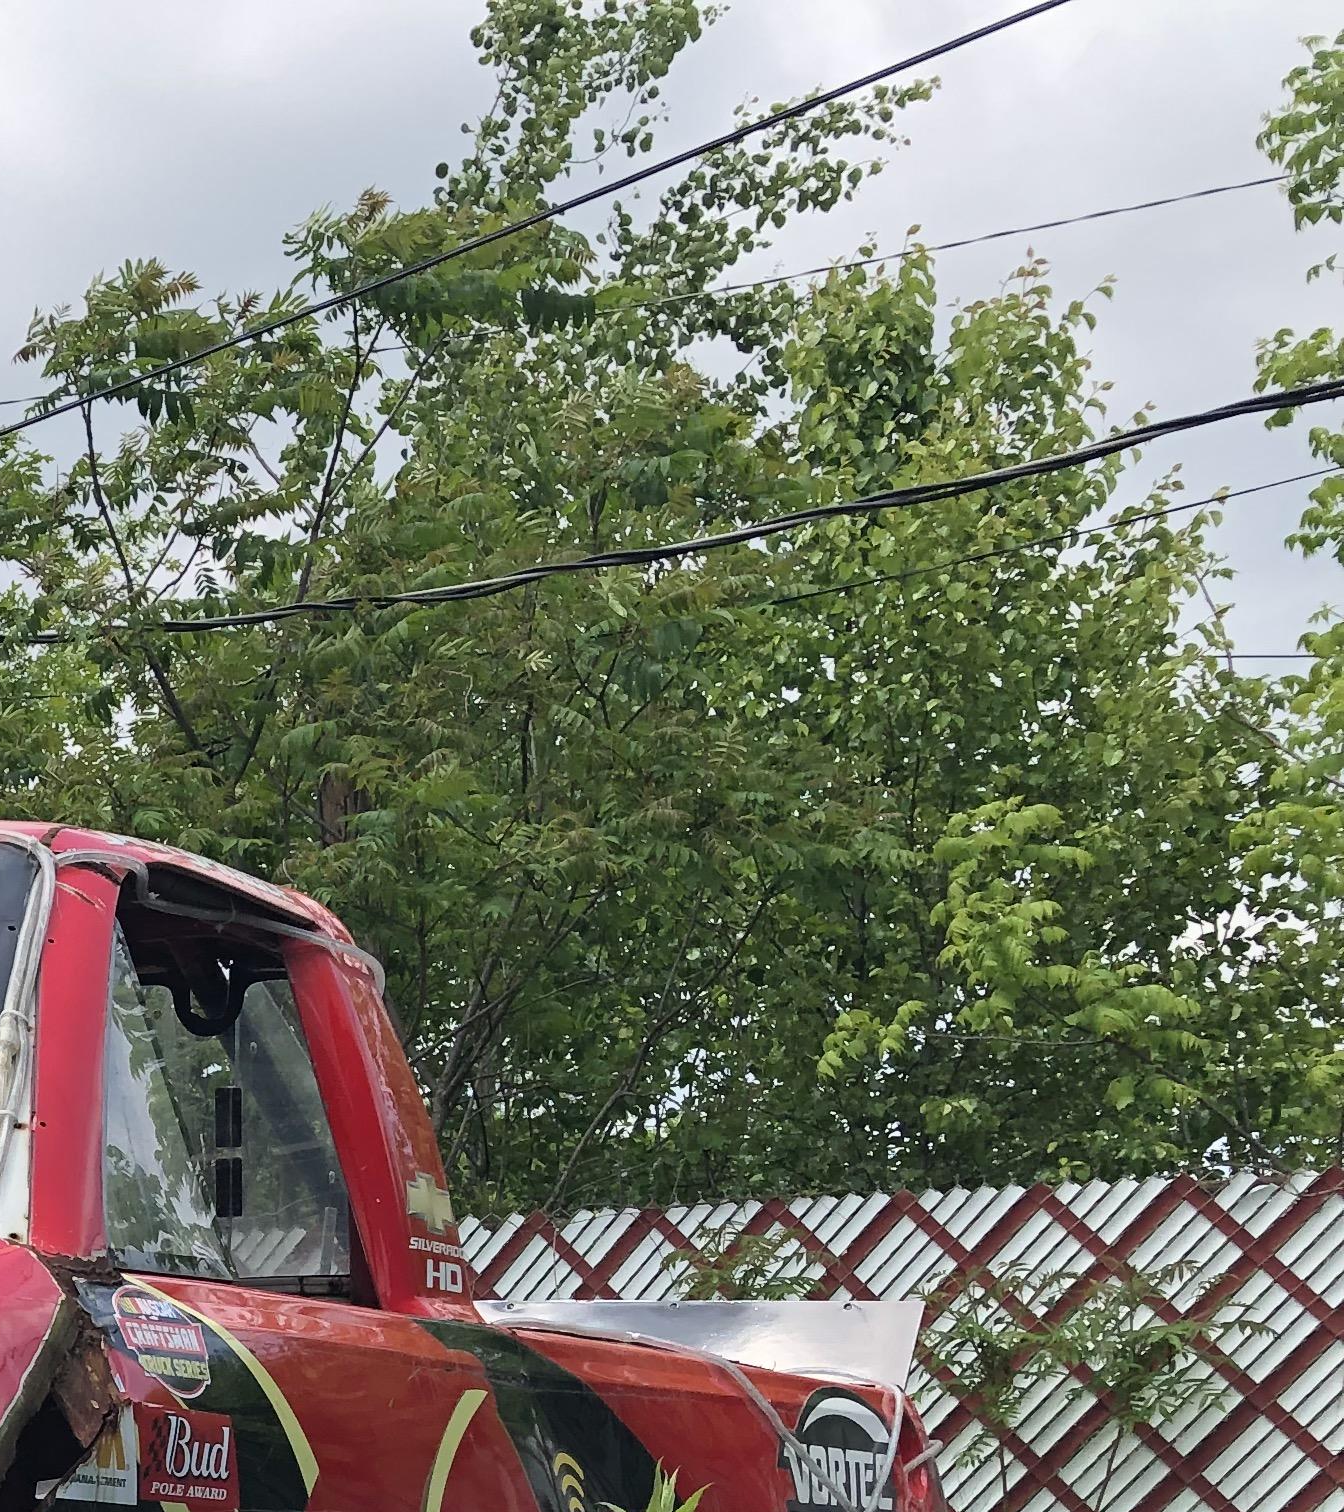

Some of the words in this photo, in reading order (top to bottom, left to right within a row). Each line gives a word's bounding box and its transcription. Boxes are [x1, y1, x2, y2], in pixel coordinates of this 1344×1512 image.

[426, 1259, 462, 1293] HD
[165, 1415, 230, 1480] Bud
[150, 1481, 185, 1496] POLE
[186, 1485, 228, 1500] AWARD
